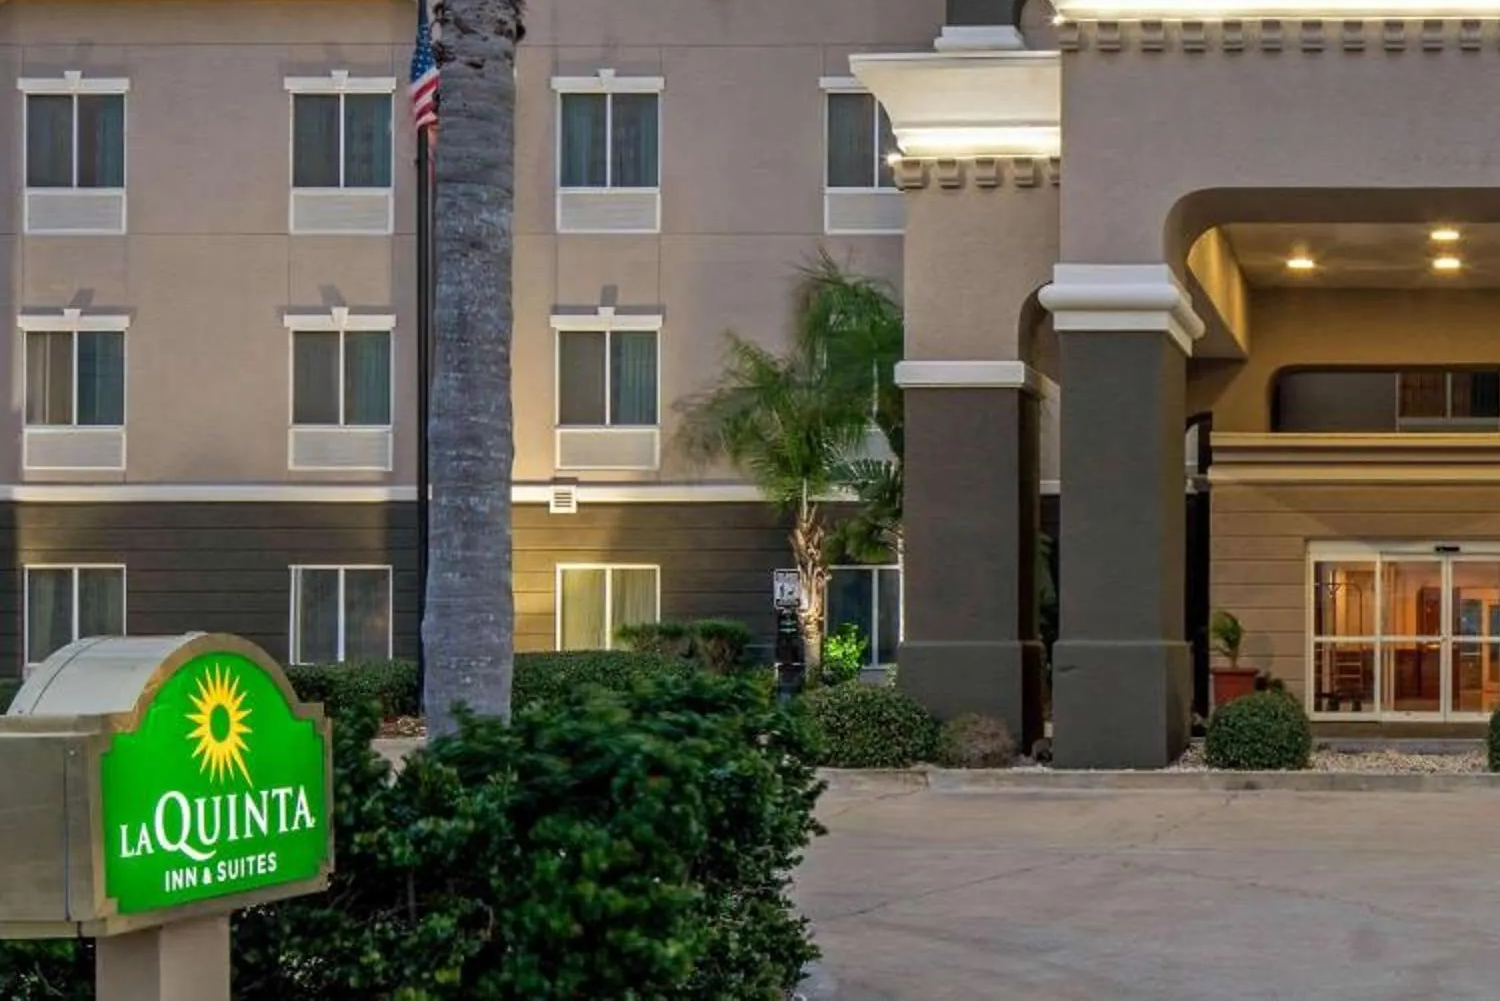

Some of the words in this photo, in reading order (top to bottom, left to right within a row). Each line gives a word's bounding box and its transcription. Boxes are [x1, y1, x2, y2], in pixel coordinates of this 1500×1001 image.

[119, 822, 155, 858] LA
[154, 785, 315, 861] QUINTA
[164, 866, 198, 893] INN
[216, 851, 278, 882] SUITES
